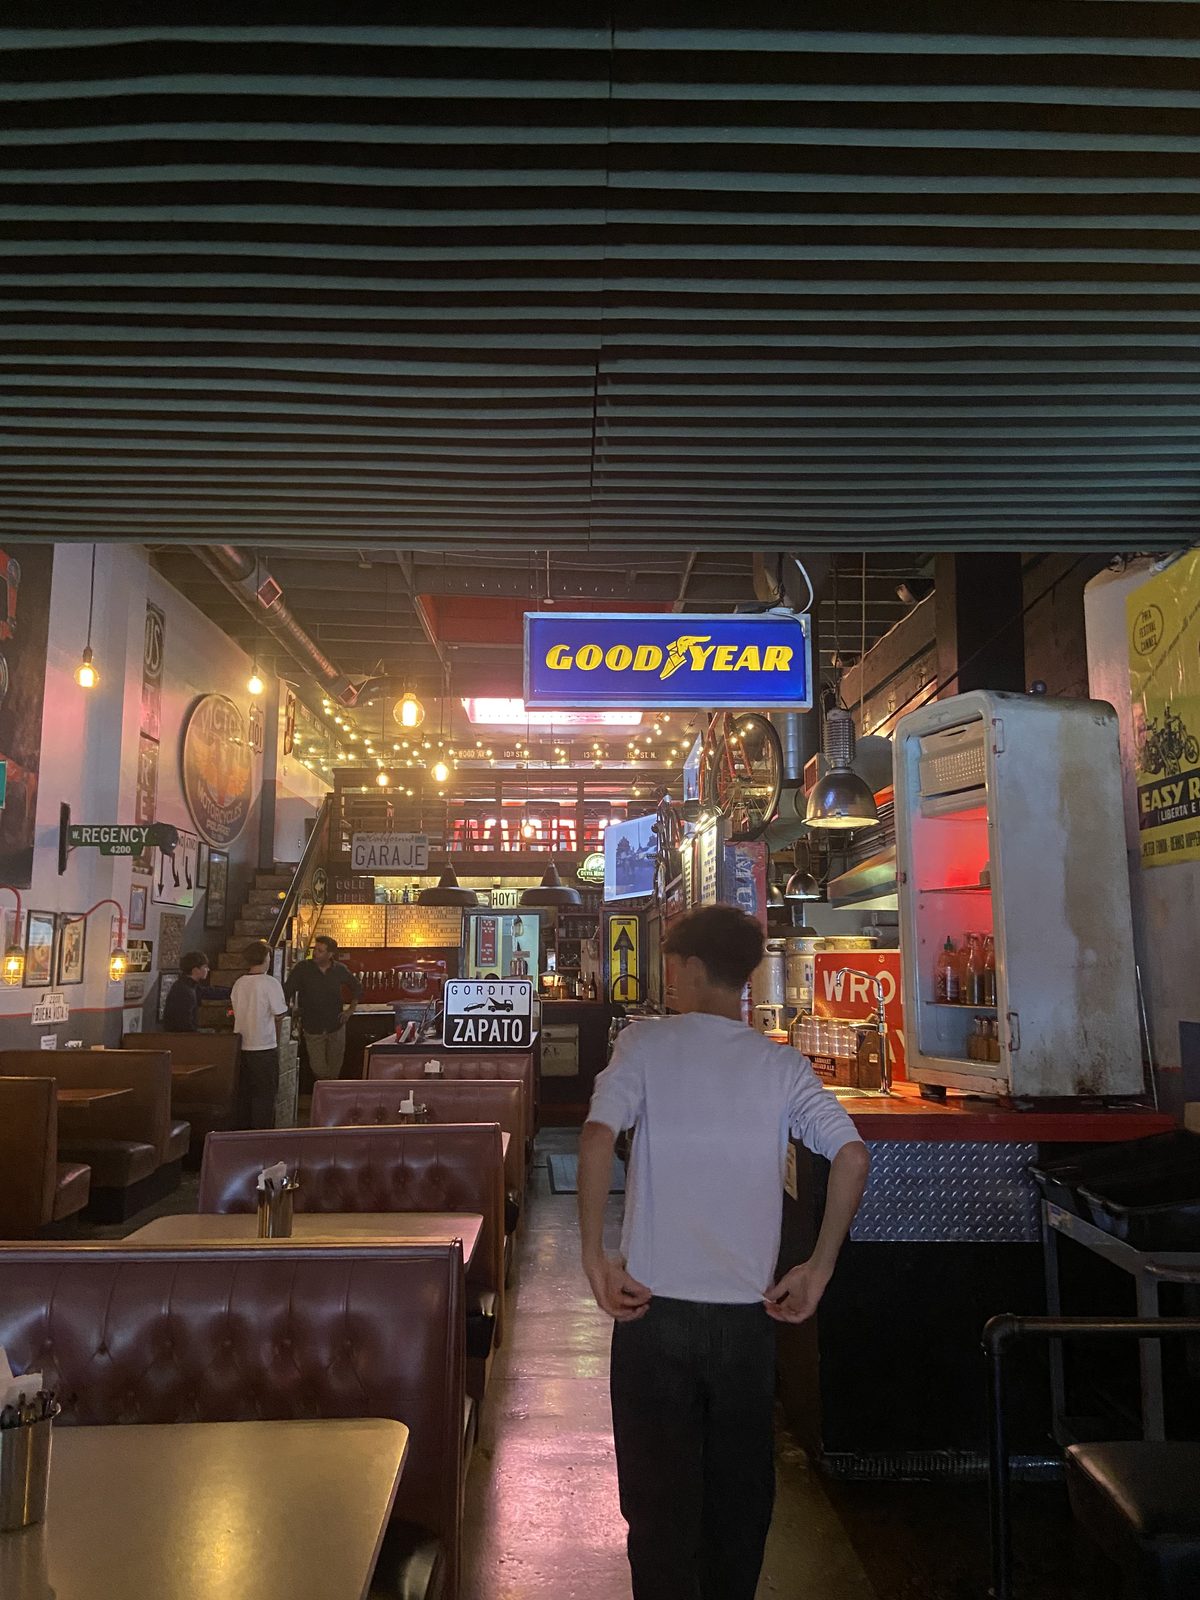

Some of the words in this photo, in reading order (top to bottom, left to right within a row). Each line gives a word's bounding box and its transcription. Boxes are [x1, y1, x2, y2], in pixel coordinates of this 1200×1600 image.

[545, 644, 663, 671] GOOD
[688, 645, 794, 671] YEAR
[1141, 780, 1184, 813] EASY
[1188, 777, 1200, 800] R
[72, 830, 80, 839] W.
[81, 827, 150, 843] REGENCY
[110, 845, 131, 854] 4200
[355, 845, 425, 866] GARAJE
[492, 892, 516, 906] HOYT
[451, 985, 527, 996] GORDITO
[823, 970, 904, 1005] WRO
[452, 1018, 523, 1043] ZAPATO
